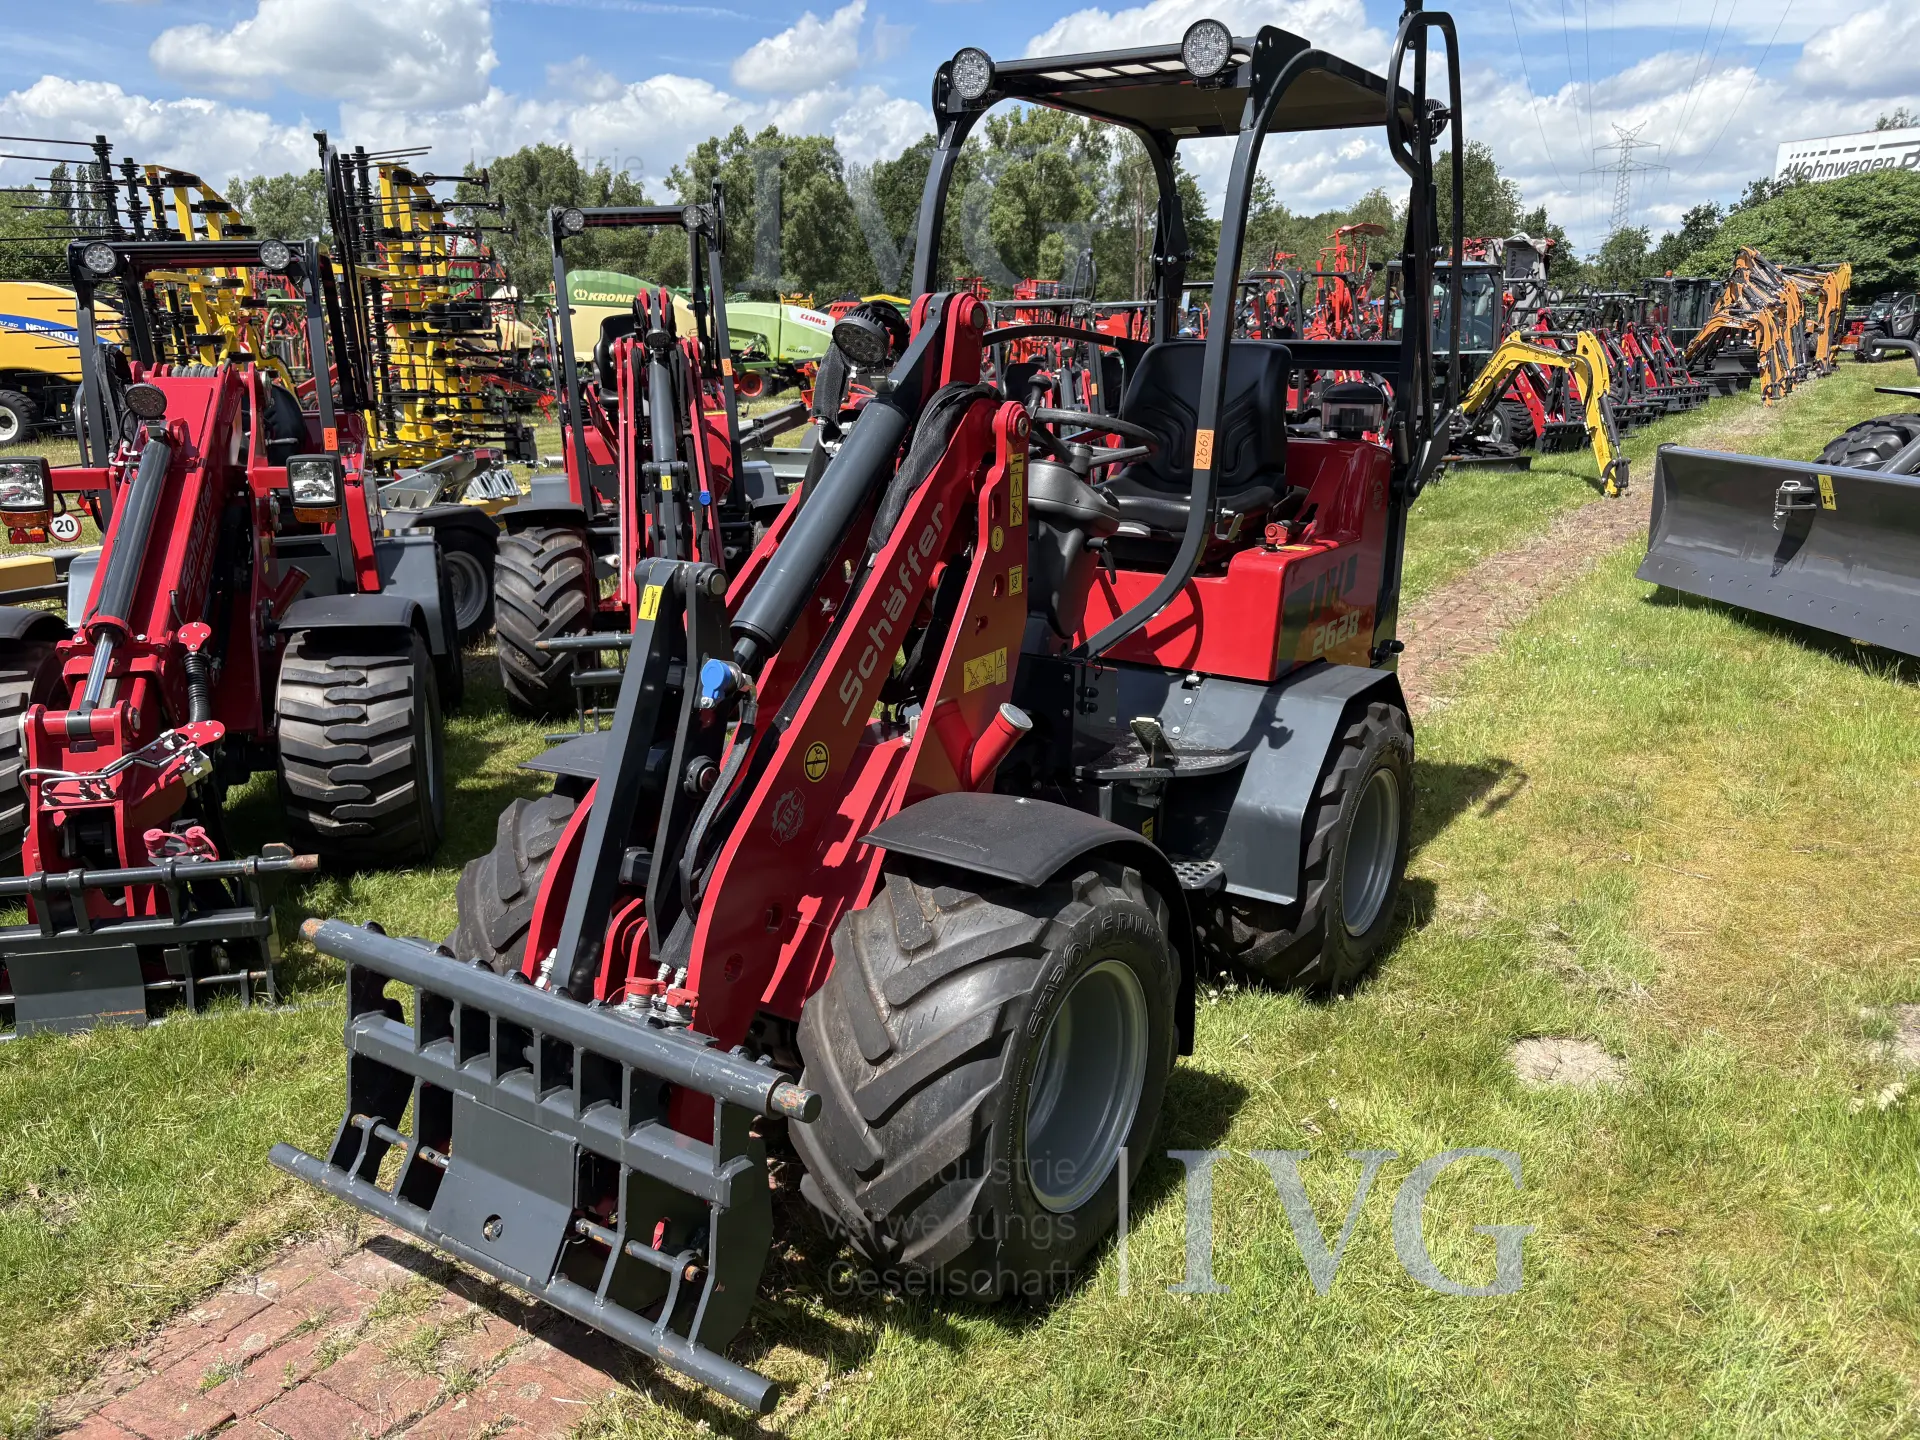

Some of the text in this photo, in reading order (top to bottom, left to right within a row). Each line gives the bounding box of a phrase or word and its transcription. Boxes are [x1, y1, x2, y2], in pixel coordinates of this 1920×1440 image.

[1788, 156, 1896, 180] Wohnwagen
[587, 292, 635, 304] KRONE
[800, 313, 828, 326] CLAAS
[50, 330, 80, 345] HOLLA
[55, 519, 75, 533] 20
[839, 502, 944, 727] Schäffer
[1312, 609, 1361, 657] 2628
